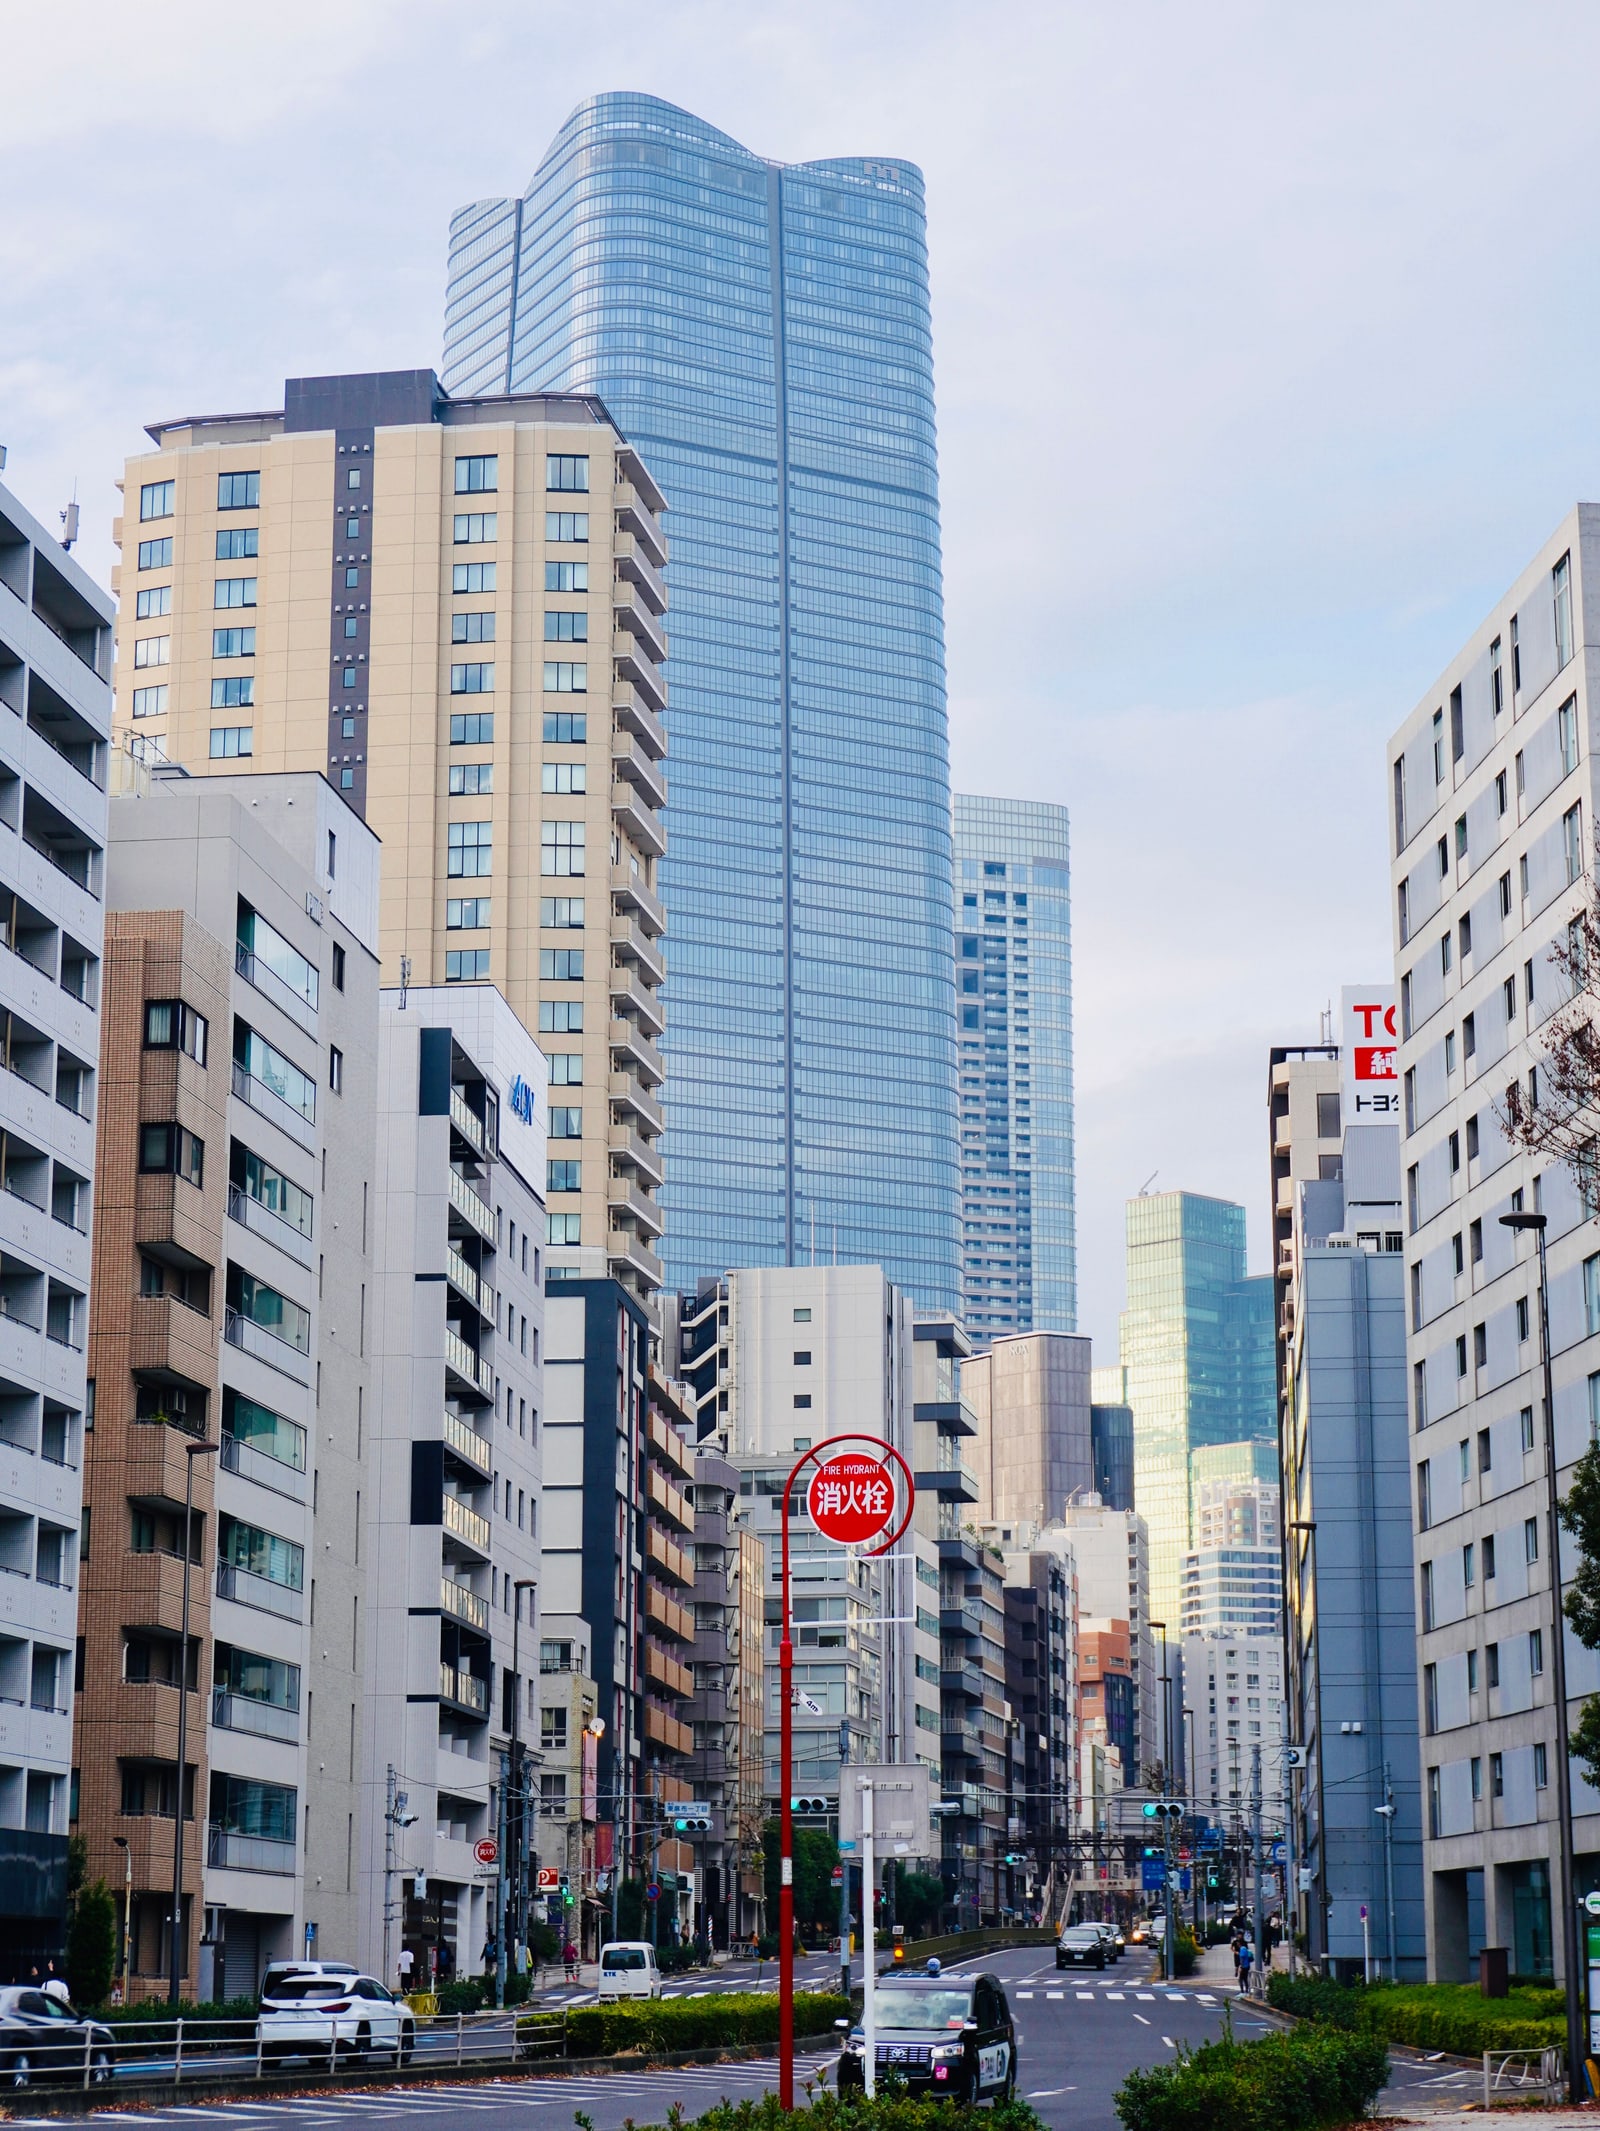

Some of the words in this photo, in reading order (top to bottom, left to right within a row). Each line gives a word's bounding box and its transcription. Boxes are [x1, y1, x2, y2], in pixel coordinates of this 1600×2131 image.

[823, 1465, 841, 1476] FIRE
[843, 1464, 880, 1475] HYDRANT
[817, 1480, 889, 1516] 消火栓
